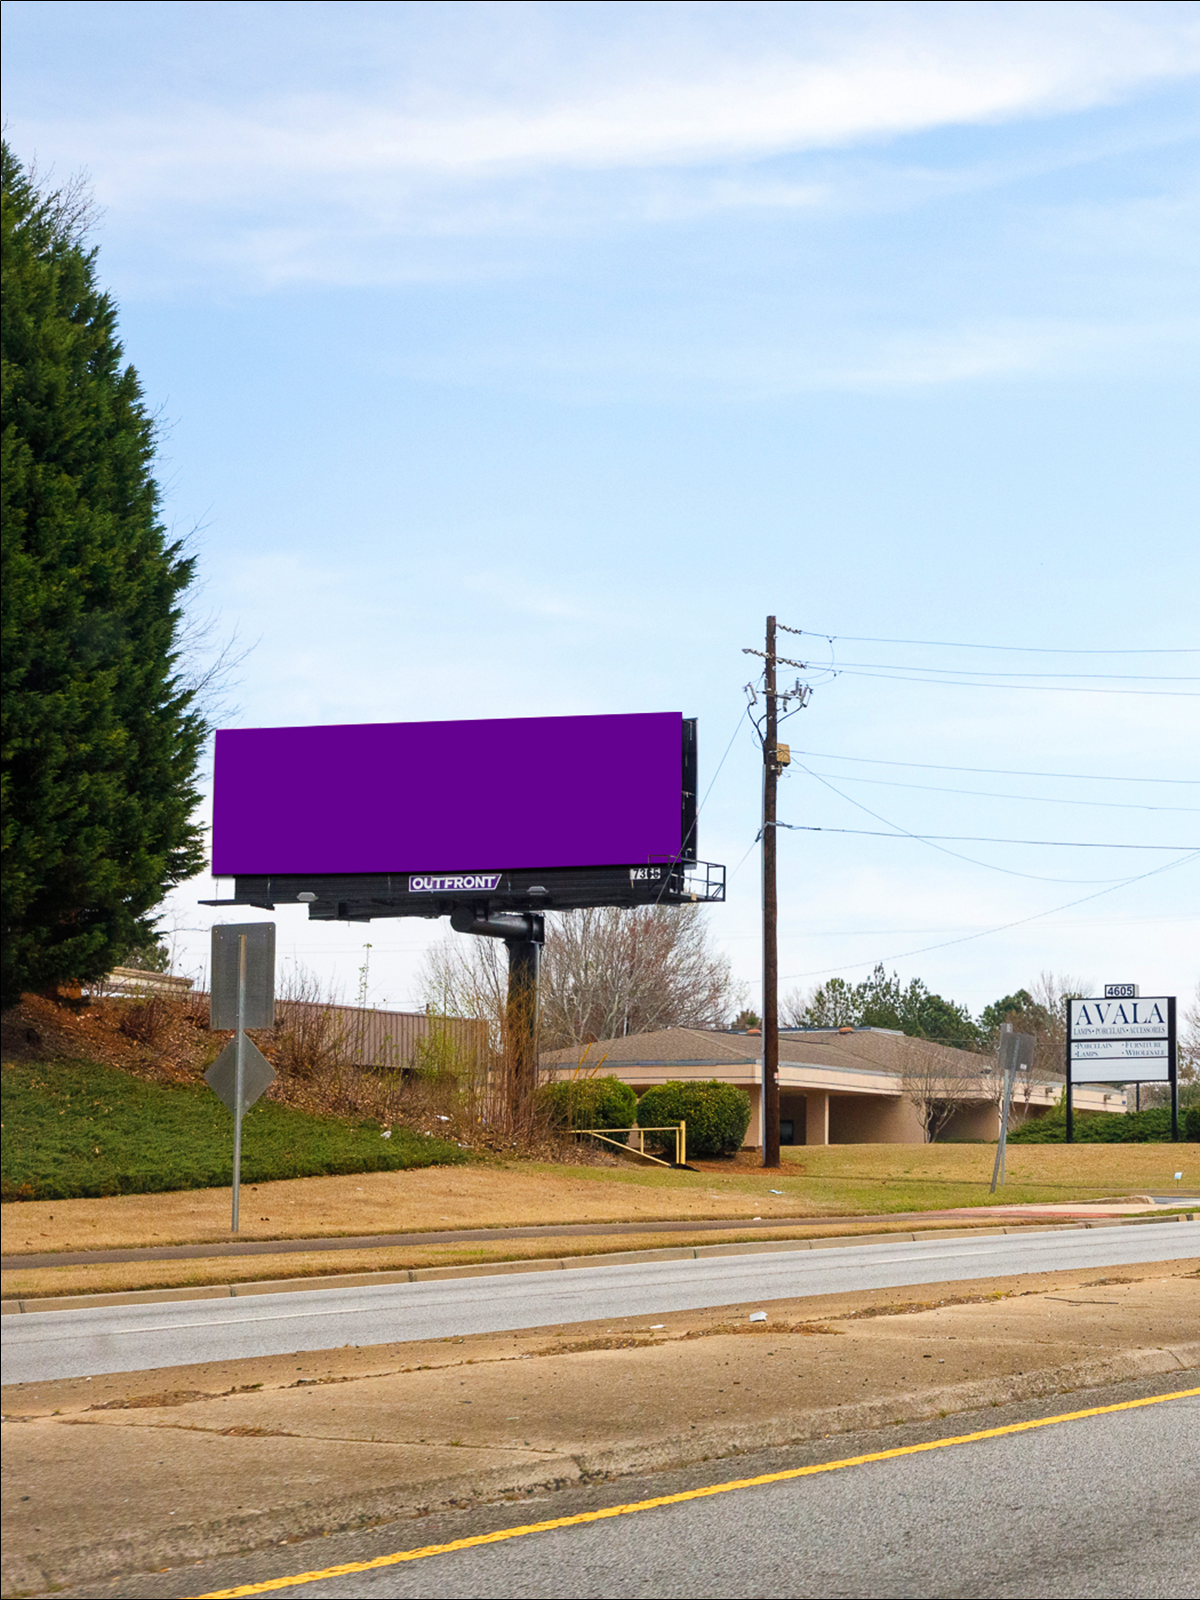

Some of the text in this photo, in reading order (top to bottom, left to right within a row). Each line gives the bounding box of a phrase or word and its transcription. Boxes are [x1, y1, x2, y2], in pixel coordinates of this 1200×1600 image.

[412, 876, 496, 890] OUTFRONT
[1107, 987, 1133, 996] 4605
[1075, 1003, 1165, 1025] AVALA
